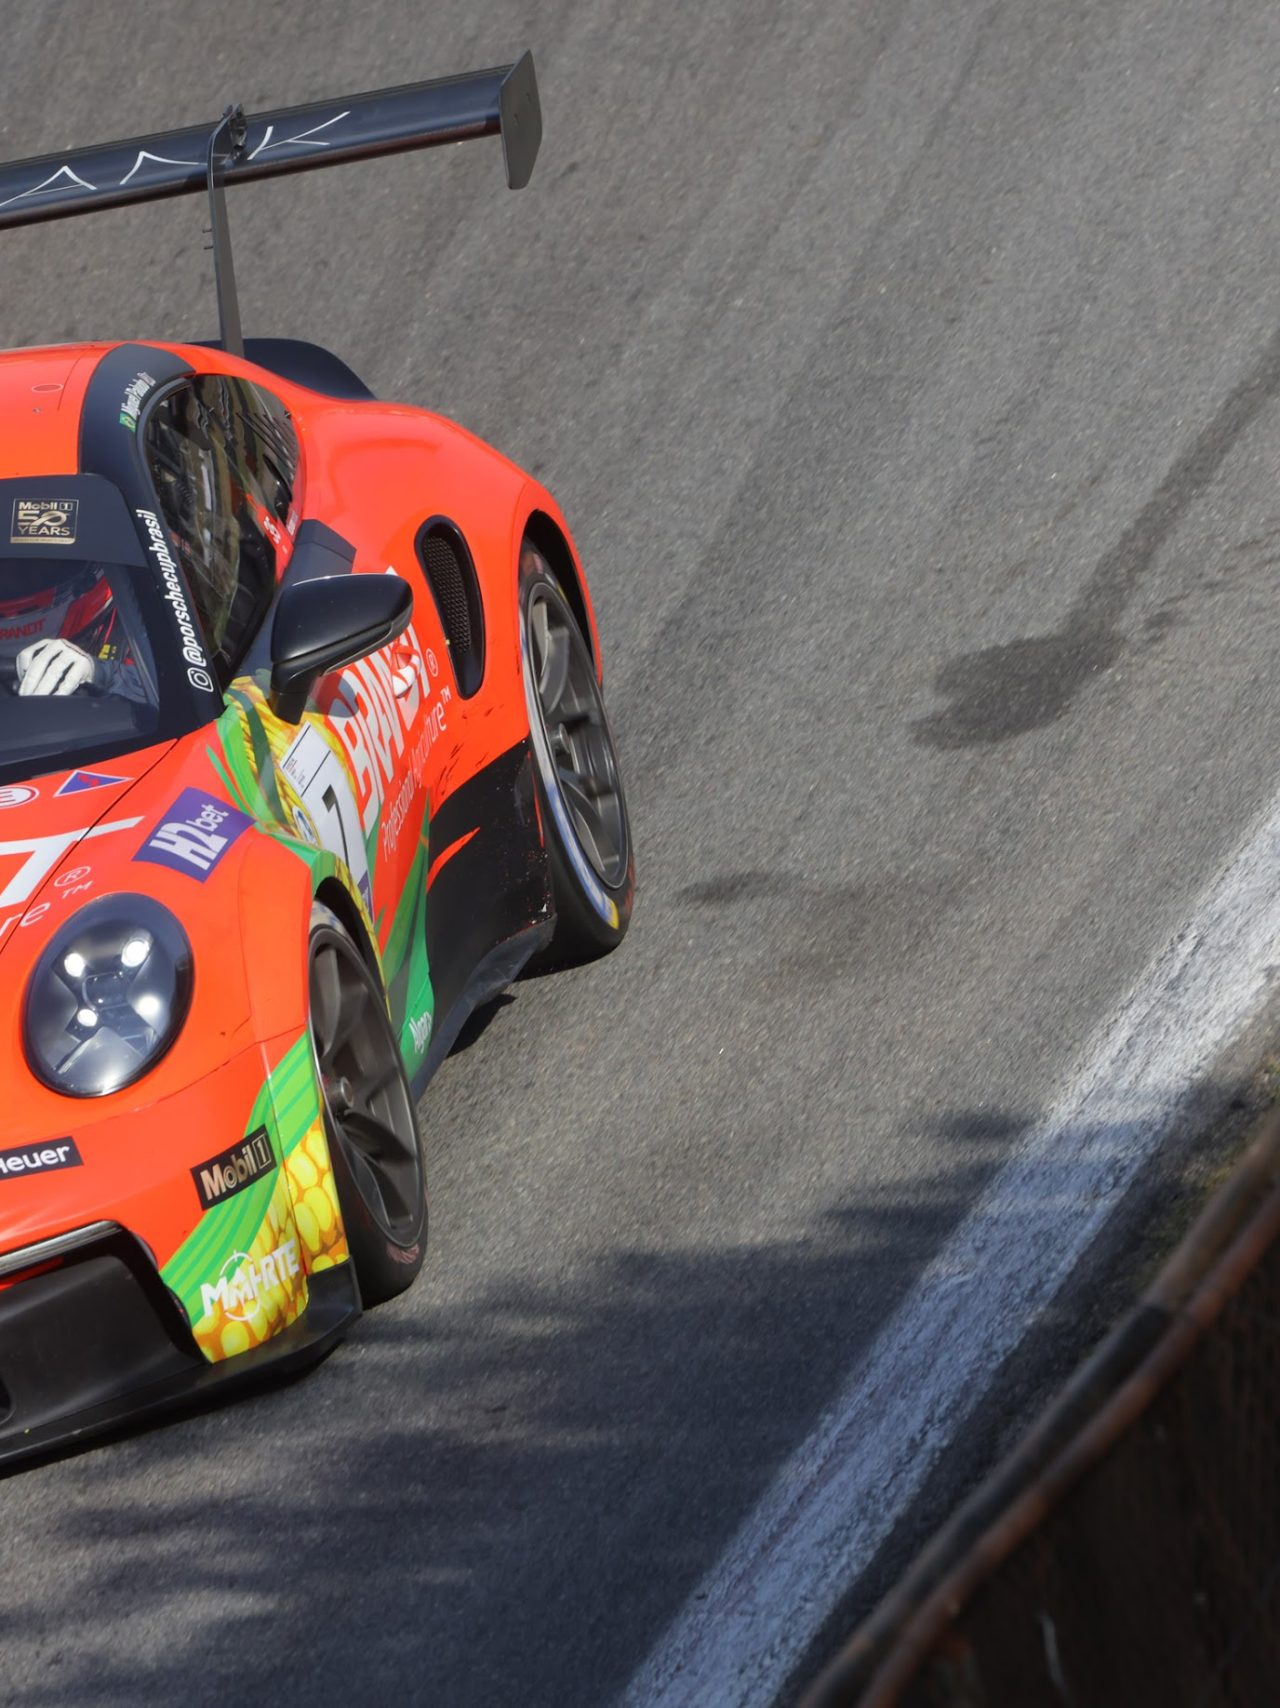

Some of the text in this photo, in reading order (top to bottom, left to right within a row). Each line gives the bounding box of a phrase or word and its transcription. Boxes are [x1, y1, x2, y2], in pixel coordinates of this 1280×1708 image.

[17, 526, 71, 536] YEARS
[137, 509, 207, 667] @porschecupbrasil
[200, 1143, 258, 1201] Mobil
